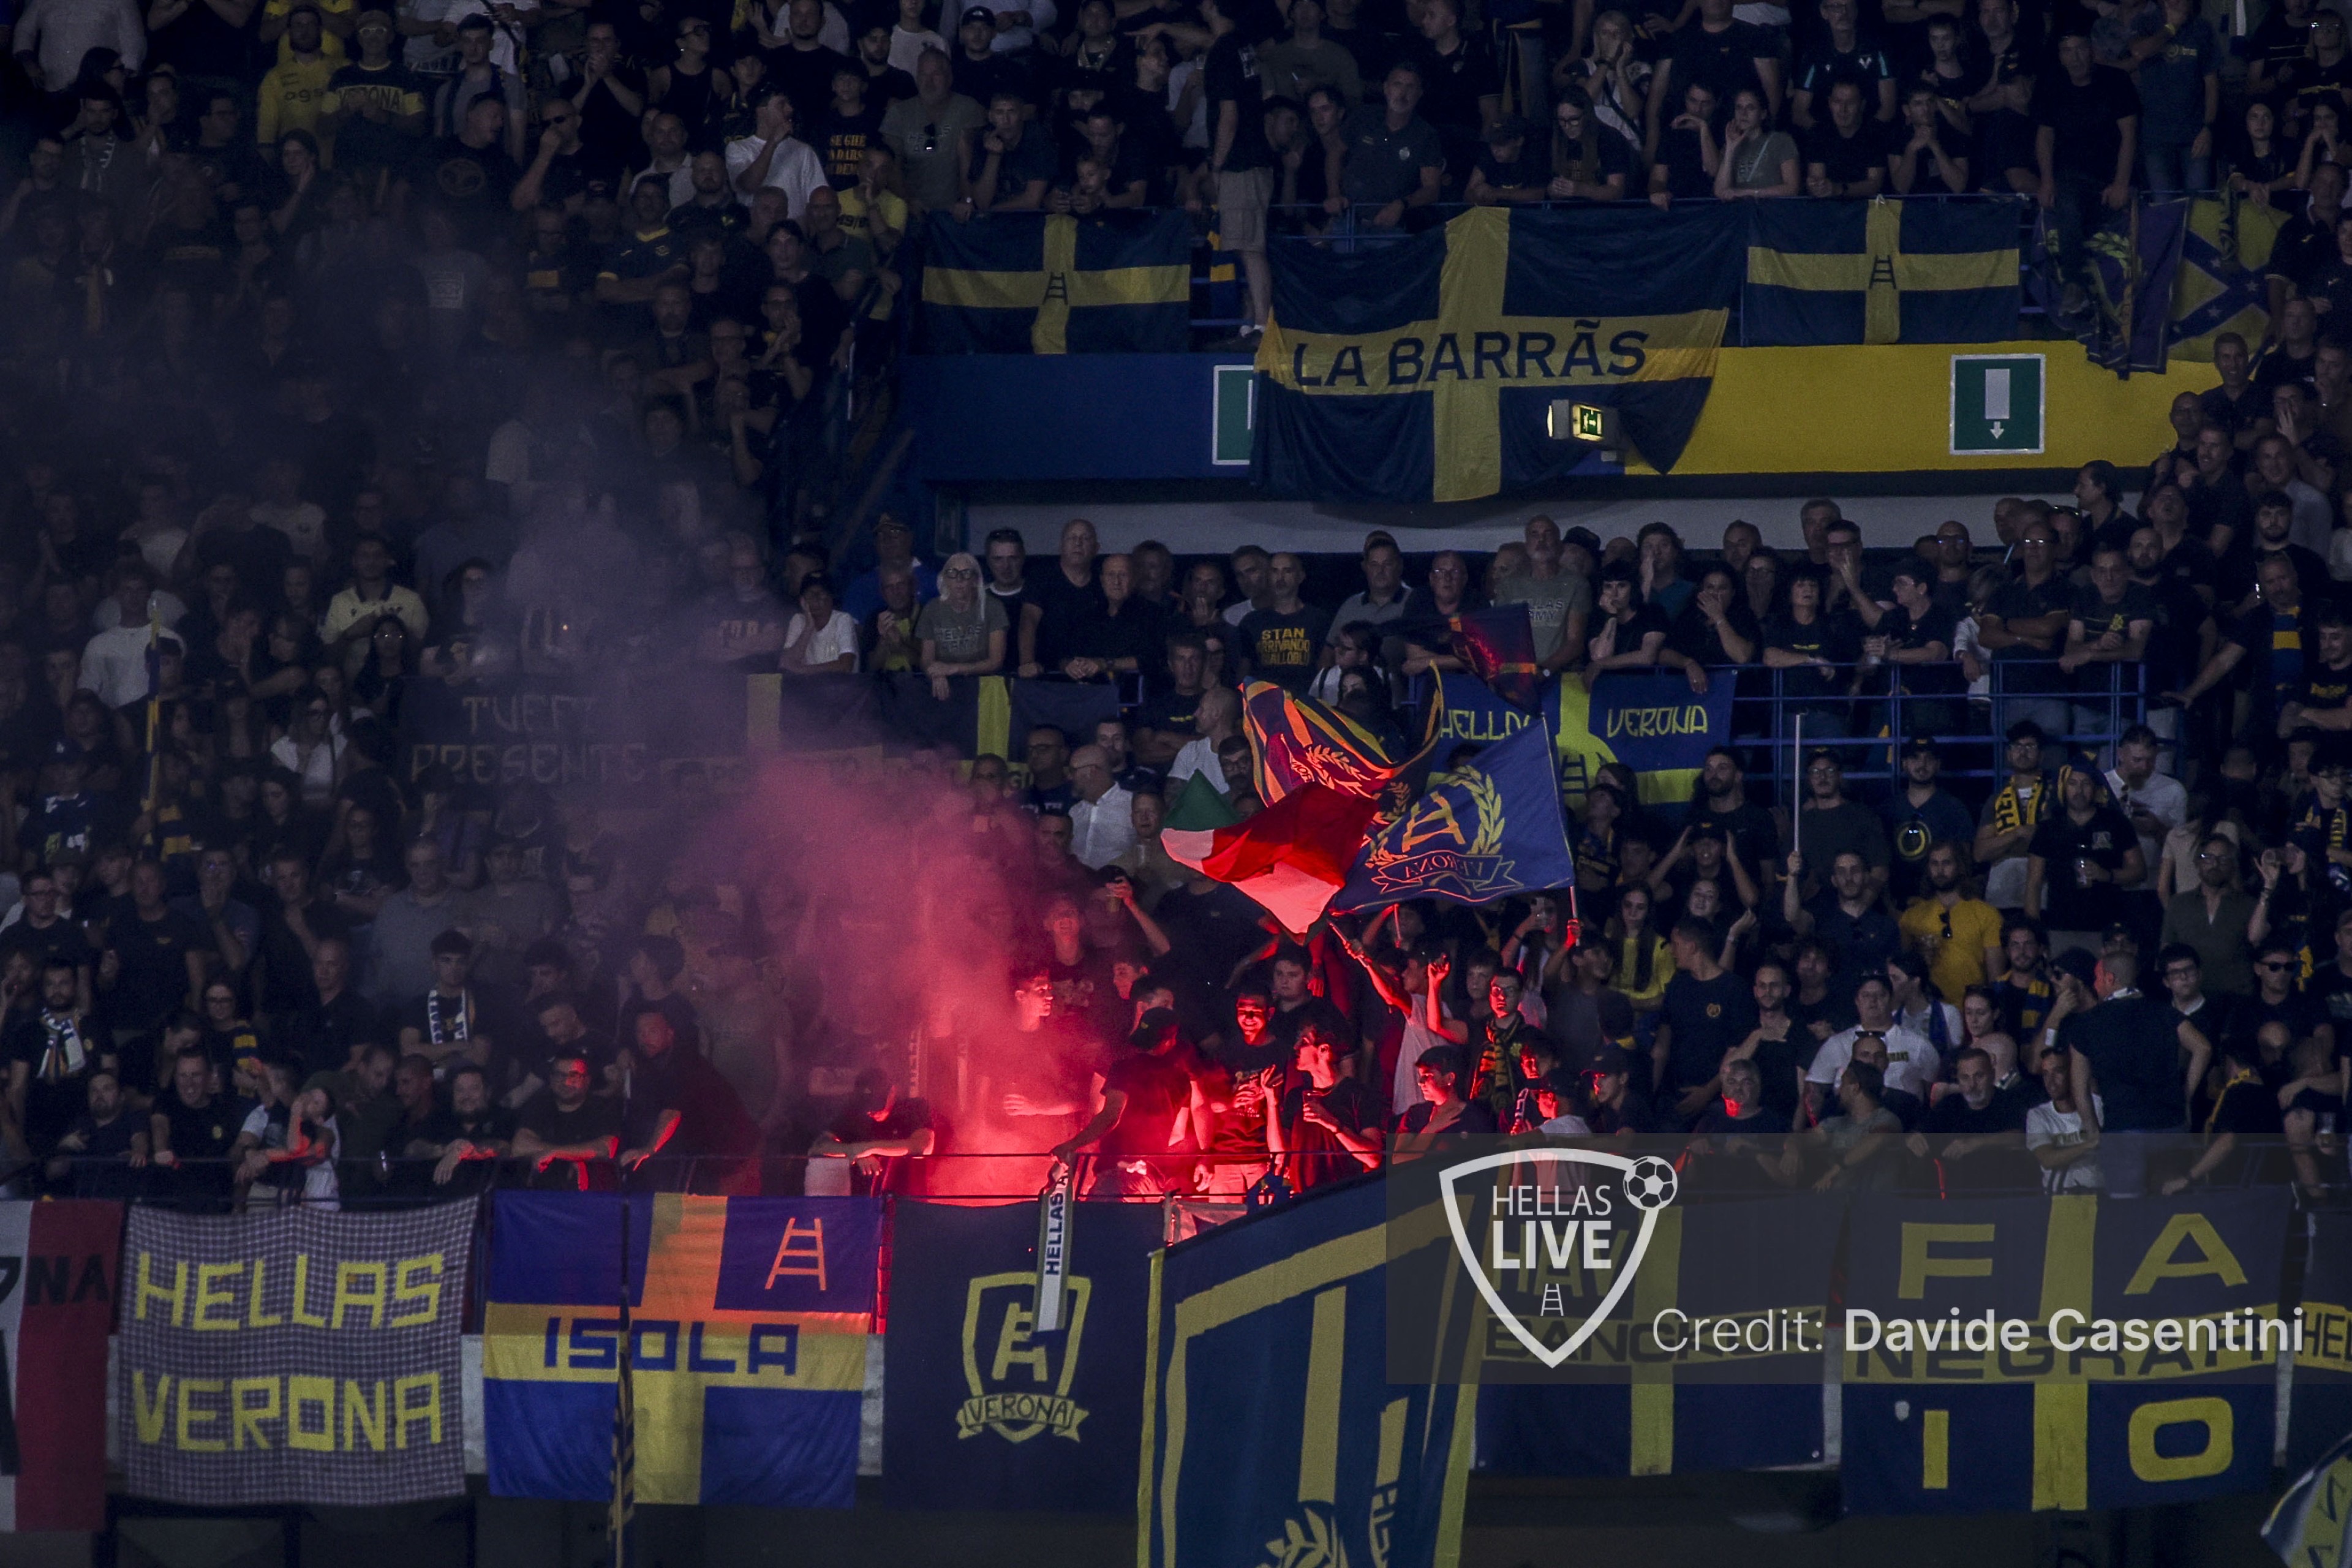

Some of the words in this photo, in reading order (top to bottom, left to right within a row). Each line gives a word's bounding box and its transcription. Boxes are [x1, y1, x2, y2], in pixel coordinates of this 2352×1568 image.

[1293, 343, 1368, 387] LA
[1388, 319, 1649, 386] BARRÃS
[1262, 627, 1305, 640] STAN
[1441, 708, 1531, 740] HELLA
[1607, 705, 1708, 738] VERONA
[1045, 1193, 1064, 1275] HELLAS
[136, 1252, 444, 1332] HELLAS
[544, 1316, 799, 1376] ISOLA
[132, 1370, 442, 1452] VERONA
[967, 1394, 1068, 1426] VERONA
